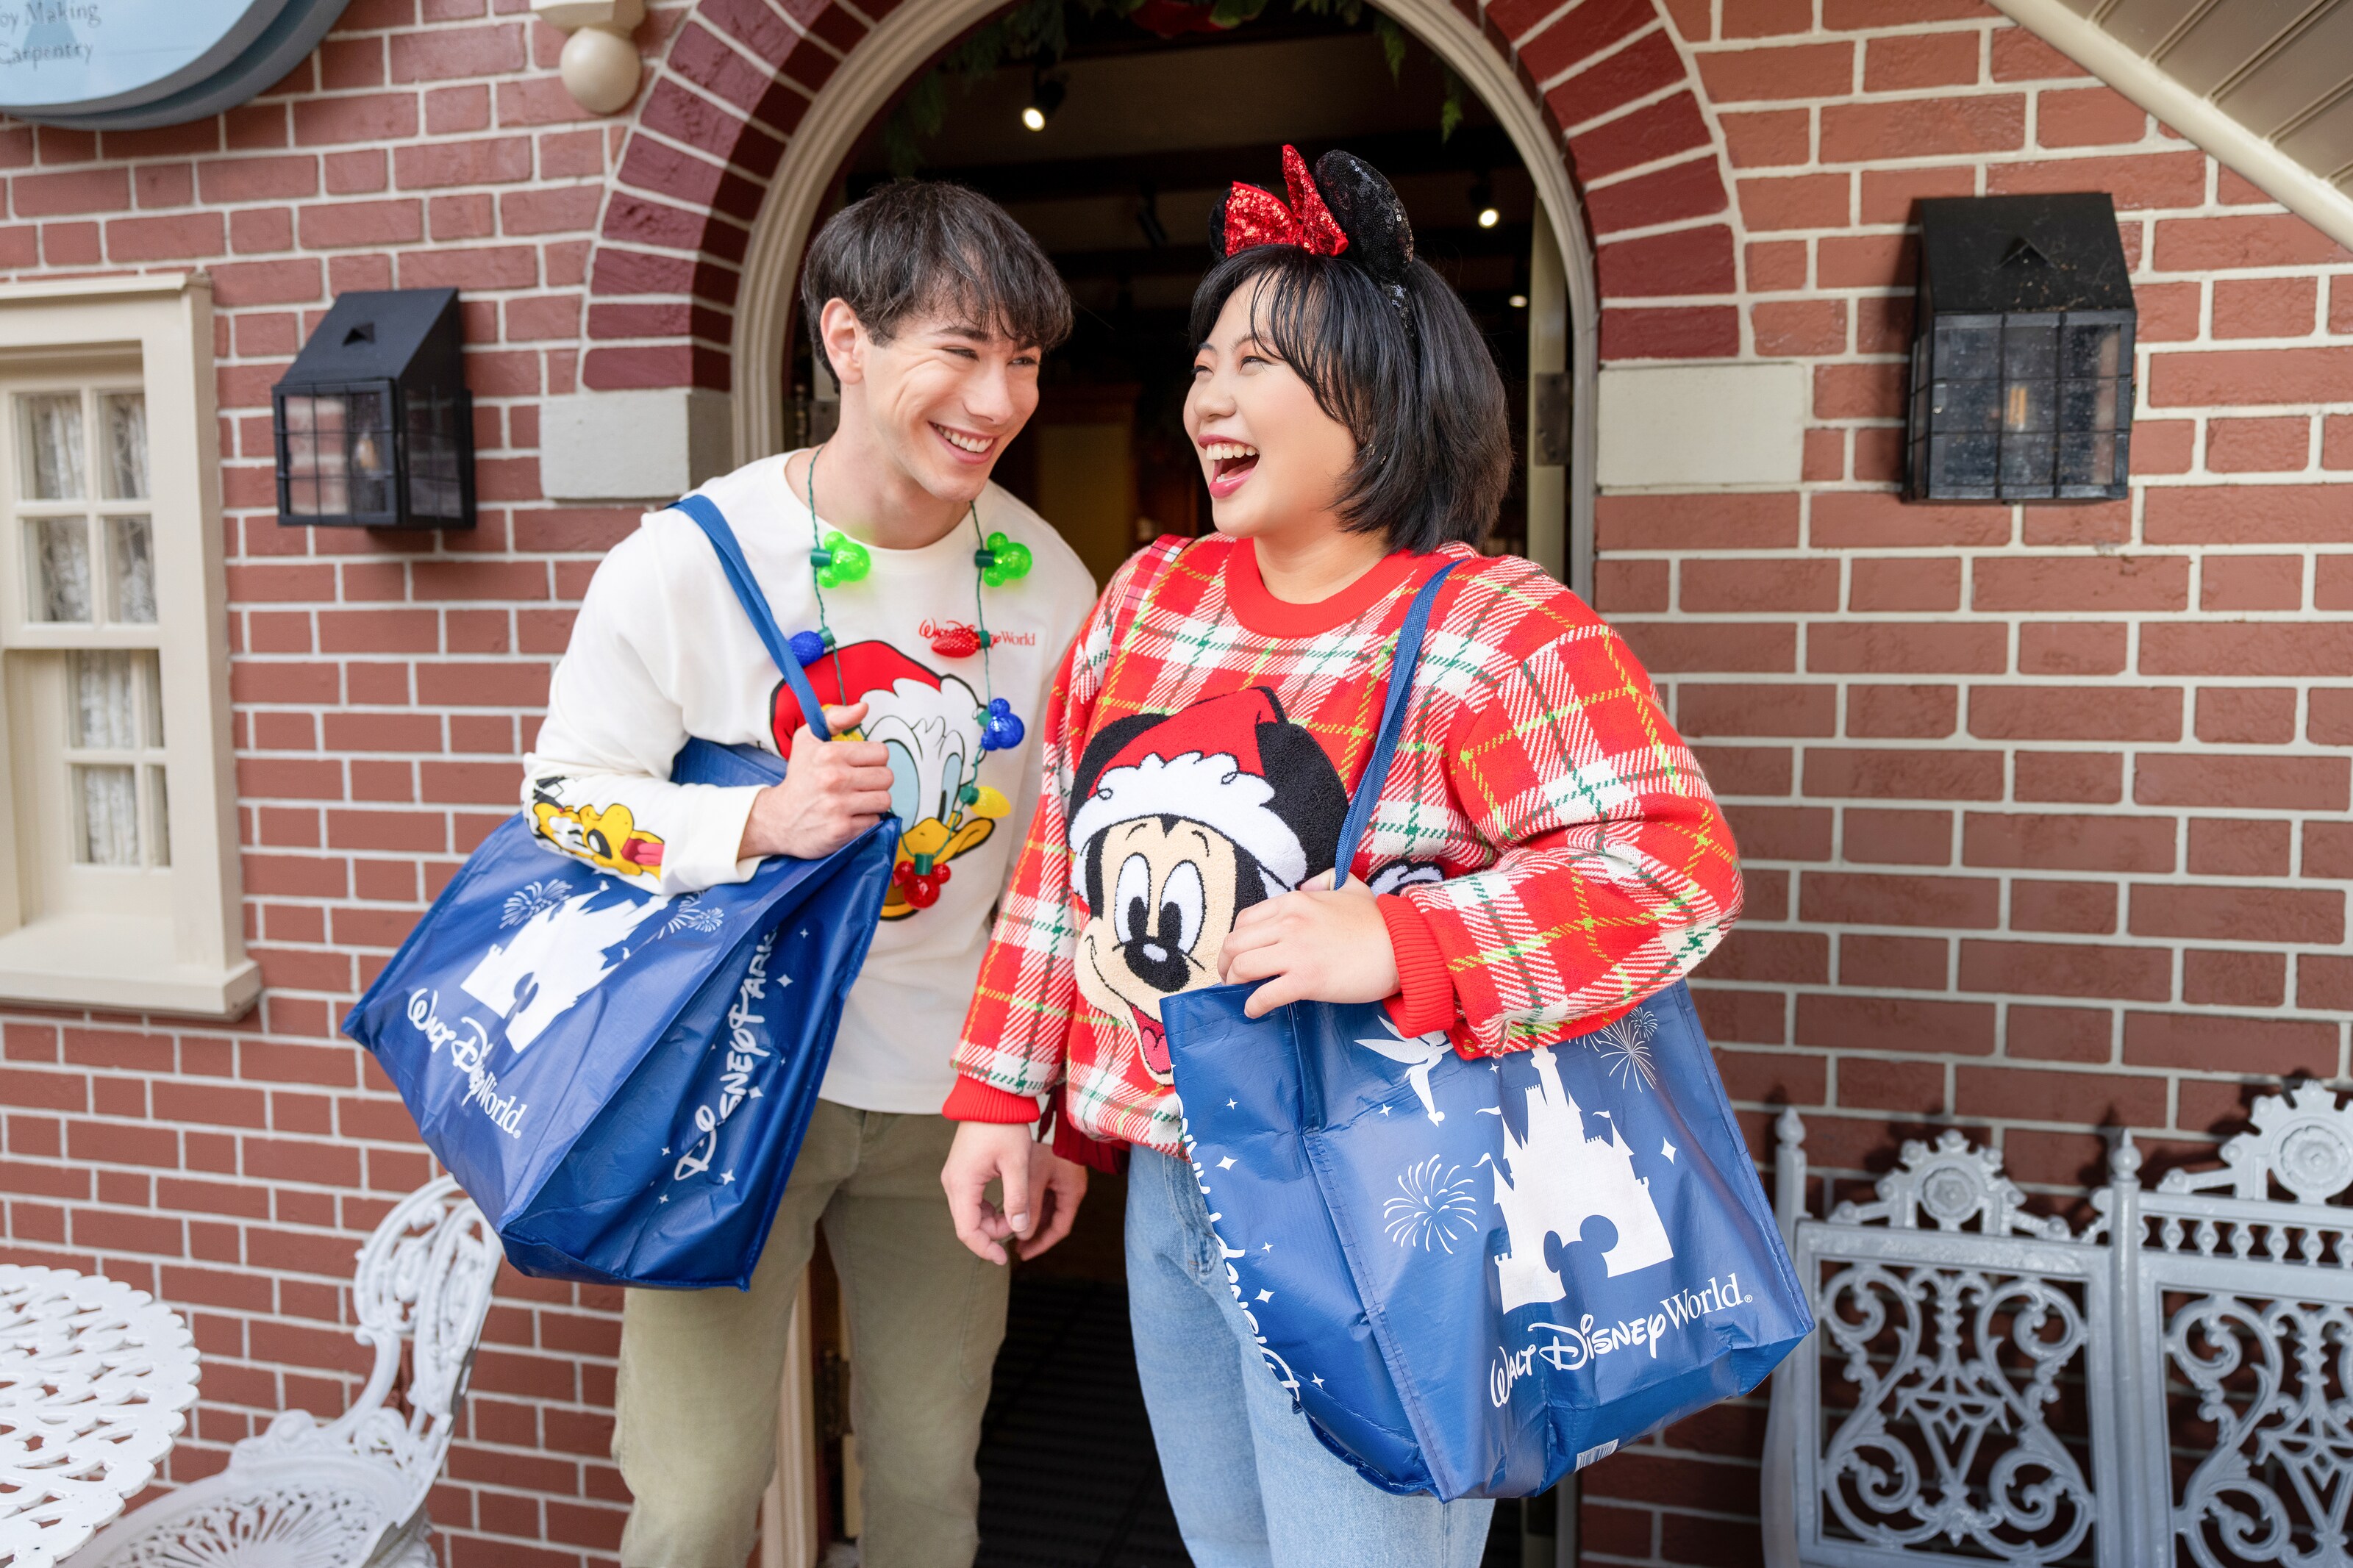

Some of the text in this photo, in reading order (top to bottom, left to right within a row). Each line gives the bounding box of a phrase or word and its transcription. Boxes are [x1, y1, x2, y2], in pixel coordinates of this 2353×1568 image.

[0, 1, 102, 36] oy Making
[1000, 631, 1035, 646] World
